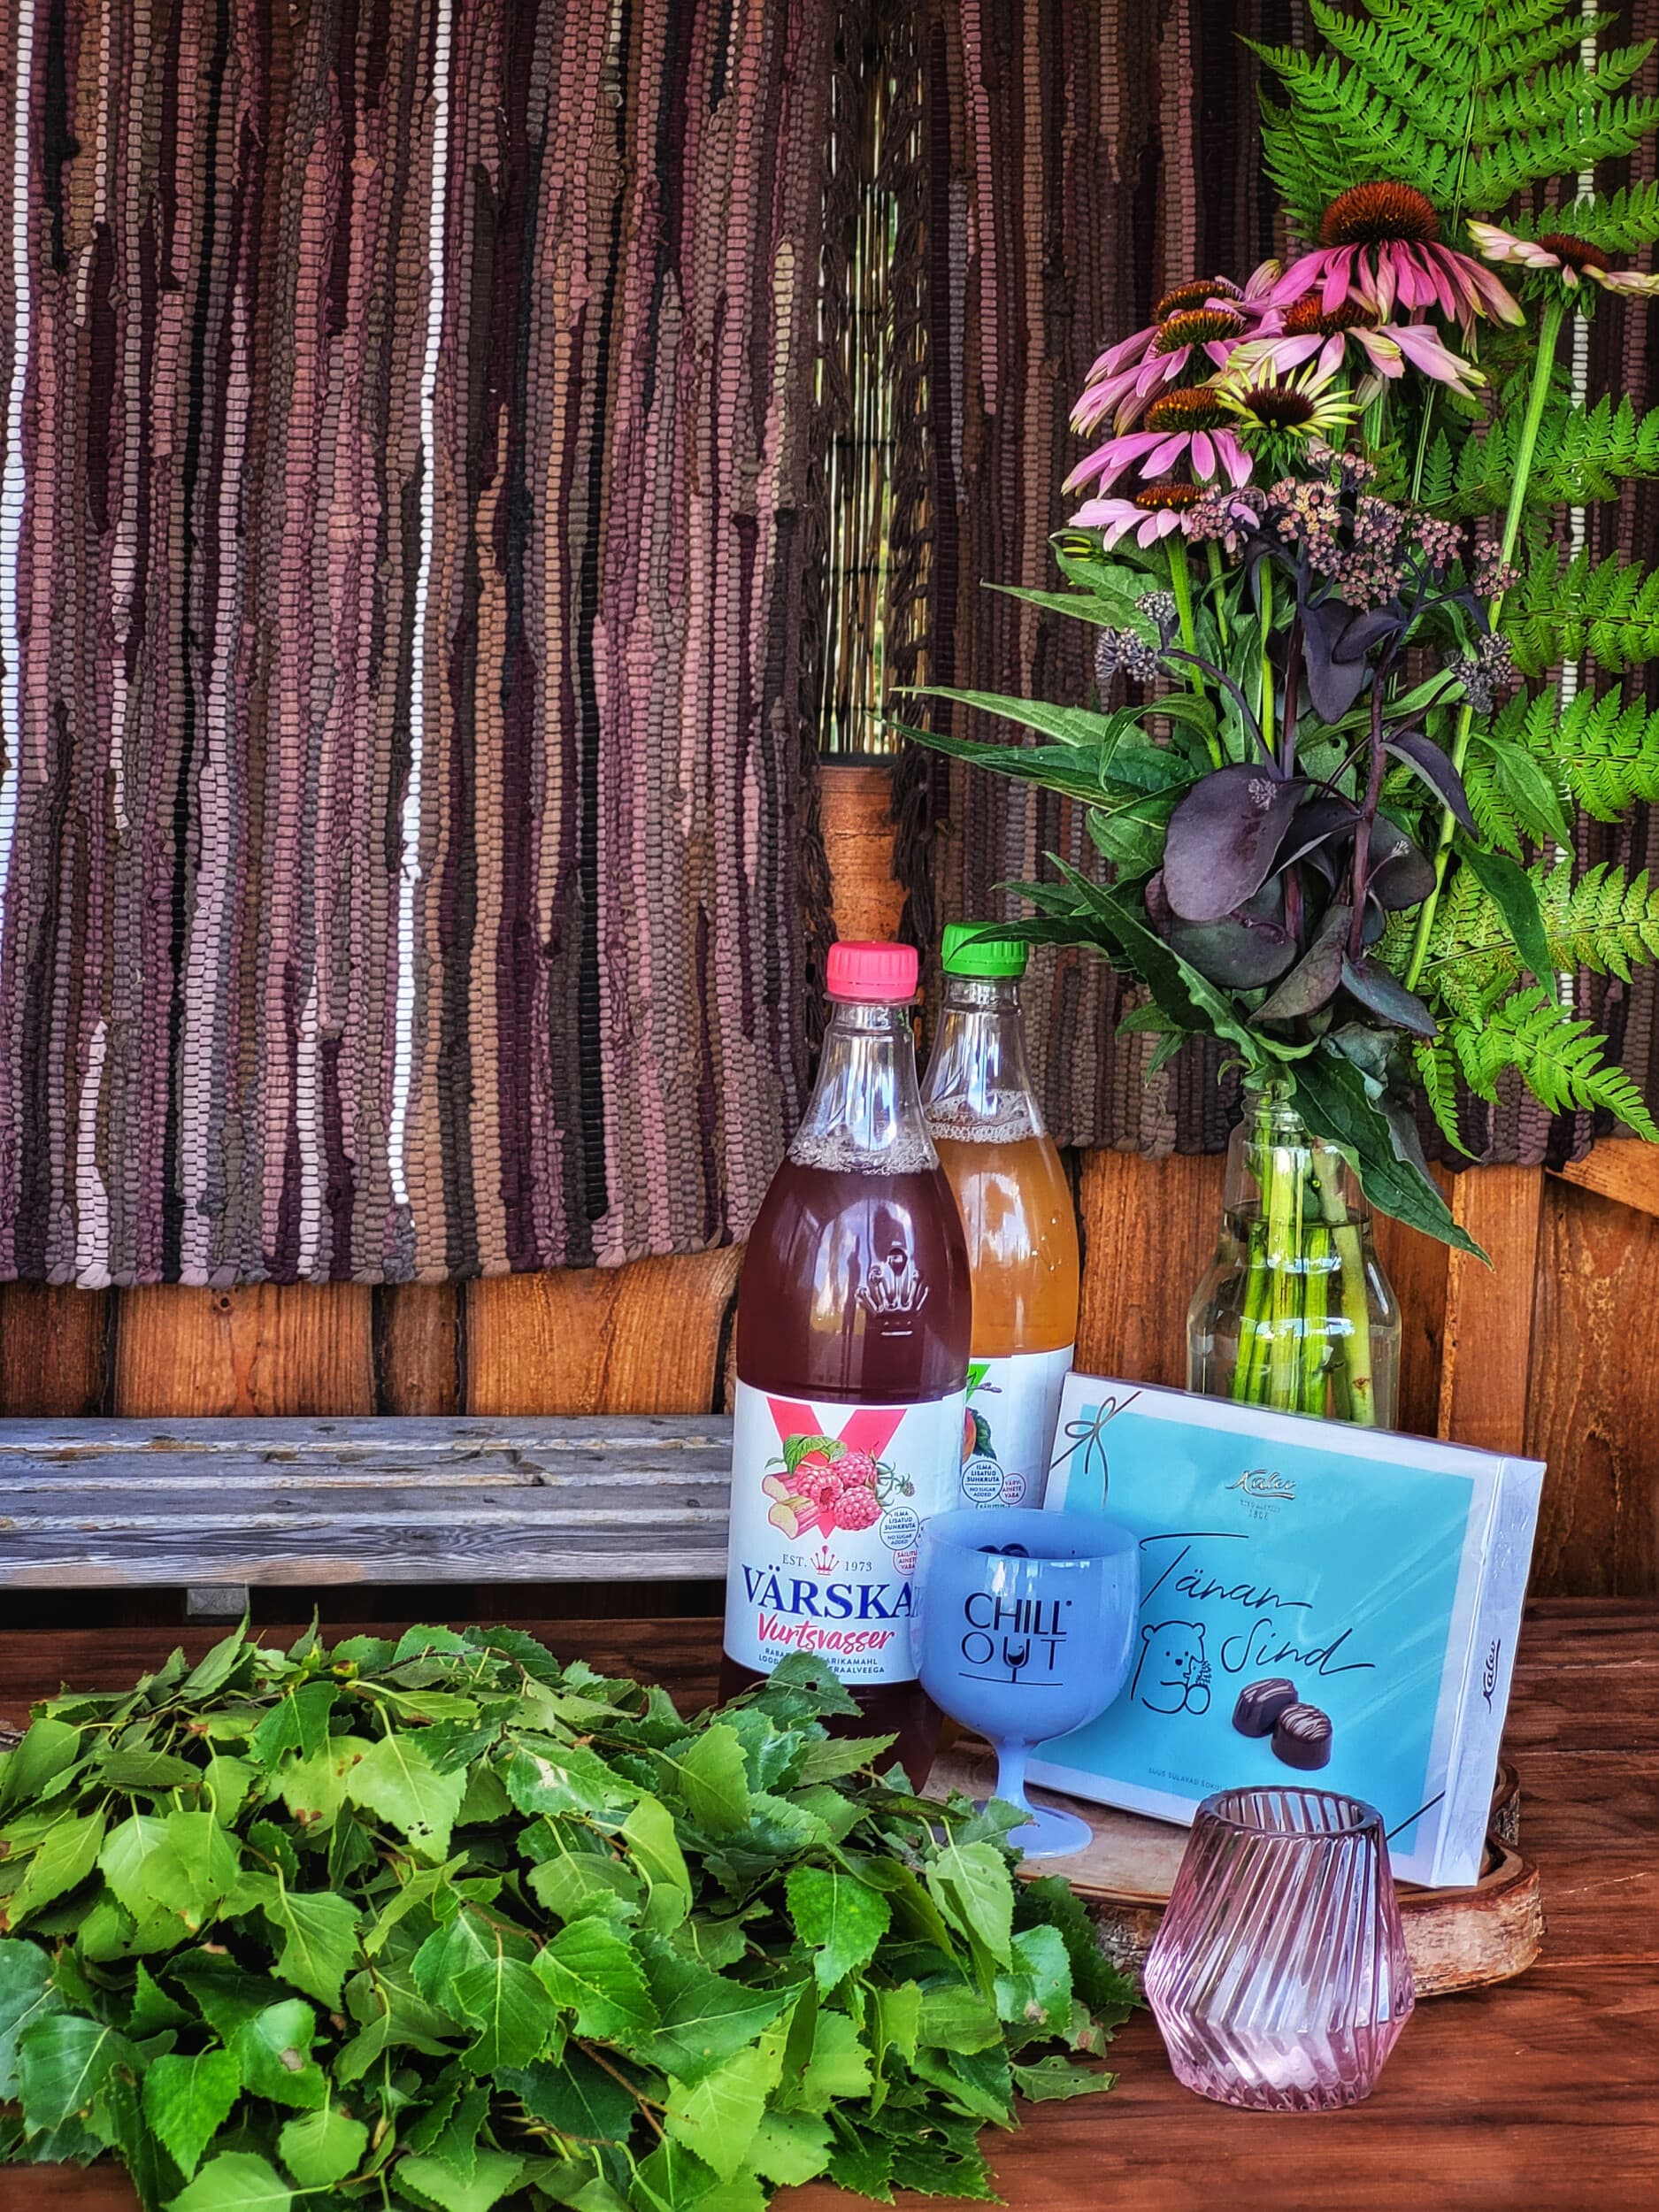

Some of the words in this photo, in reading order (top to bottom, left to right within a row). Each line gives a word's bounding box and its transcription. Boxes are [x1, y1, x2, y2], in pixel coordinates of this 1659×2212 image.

[782, 1554, 808, 1568] EST.
[844, 1561, 872, 1572] 1973
[741, 1563, 917, 1620] VÄRSKA
[964, 1592, 1068, 1635] CHILL
[758, 1612, 895, 1655] Vurtsvasser
[961, 1631, 1067, 1677] OUT
[1221, 1617, 1376, 1676] Sind
